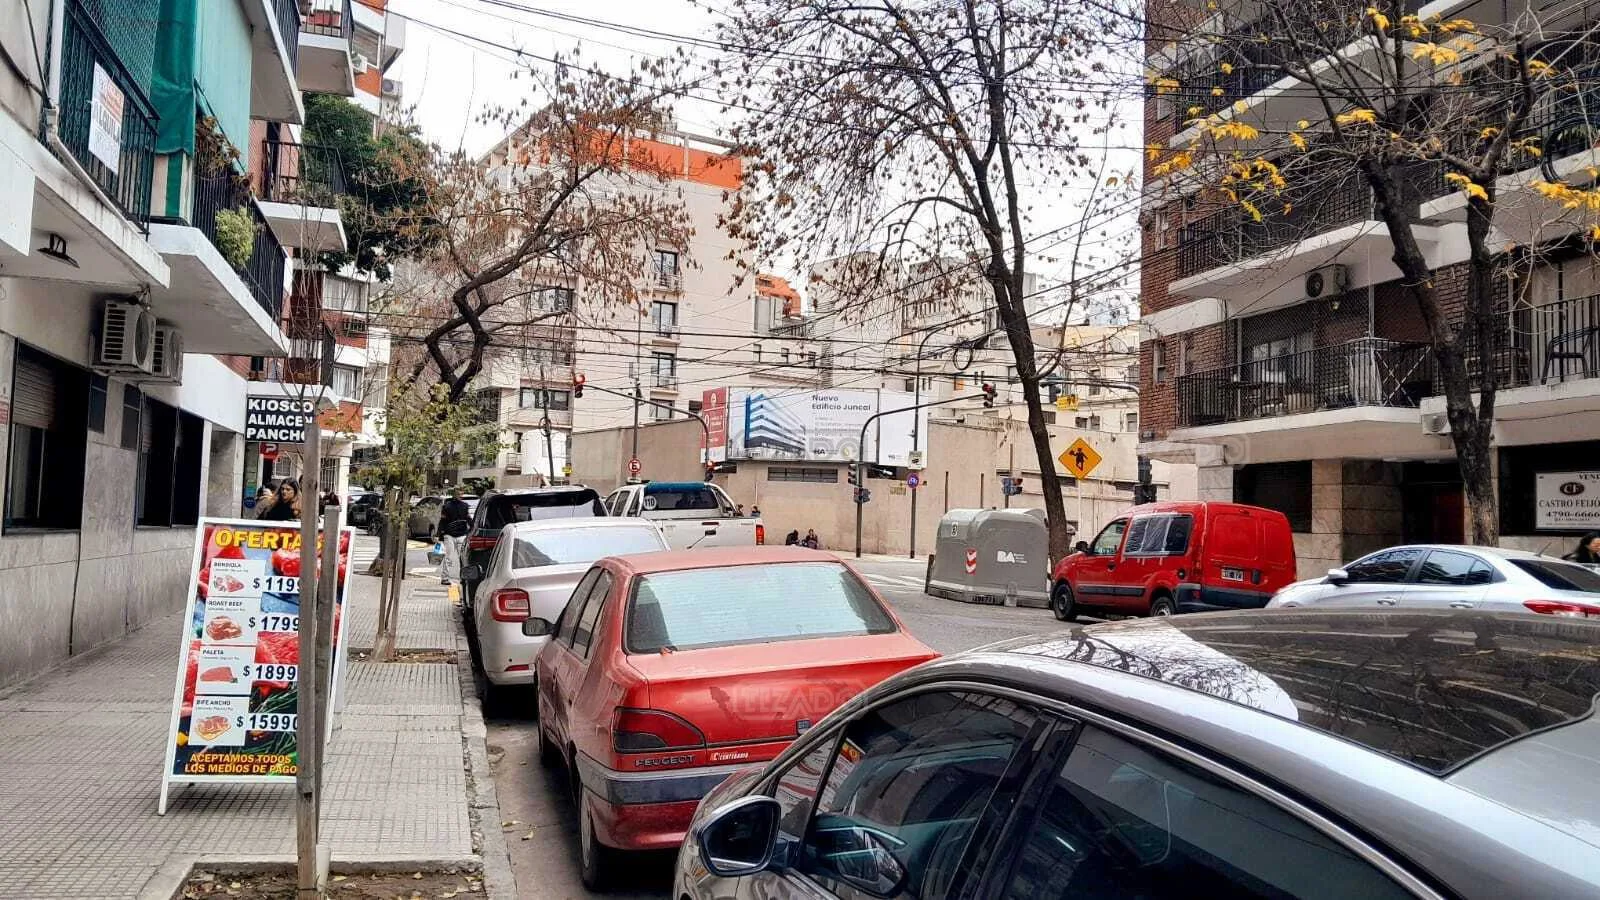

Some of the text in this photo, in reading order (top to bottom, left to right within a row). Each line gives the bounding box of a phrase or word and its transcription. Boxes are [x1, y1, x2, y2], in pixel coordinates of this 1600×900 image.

[811, 394, 839, 402] Nuevo
[248, 399, 314, 413] KIOSCO
[644, 498, 655, 508] 110
[1539, 500, 1573, 508] CASTRO
[253, 577, 260, 589] $
[249, 616, 256, 628] $
[243, 665, 250, 676] $
[236, 716, 244, 728] $
[190, 753, 292, 764] ACEPTAMOS TODOS
[635, 755, 694, 766] PEUGEOT
[184, 763, 297, 774] LOS MEDIOS DE PAGO
